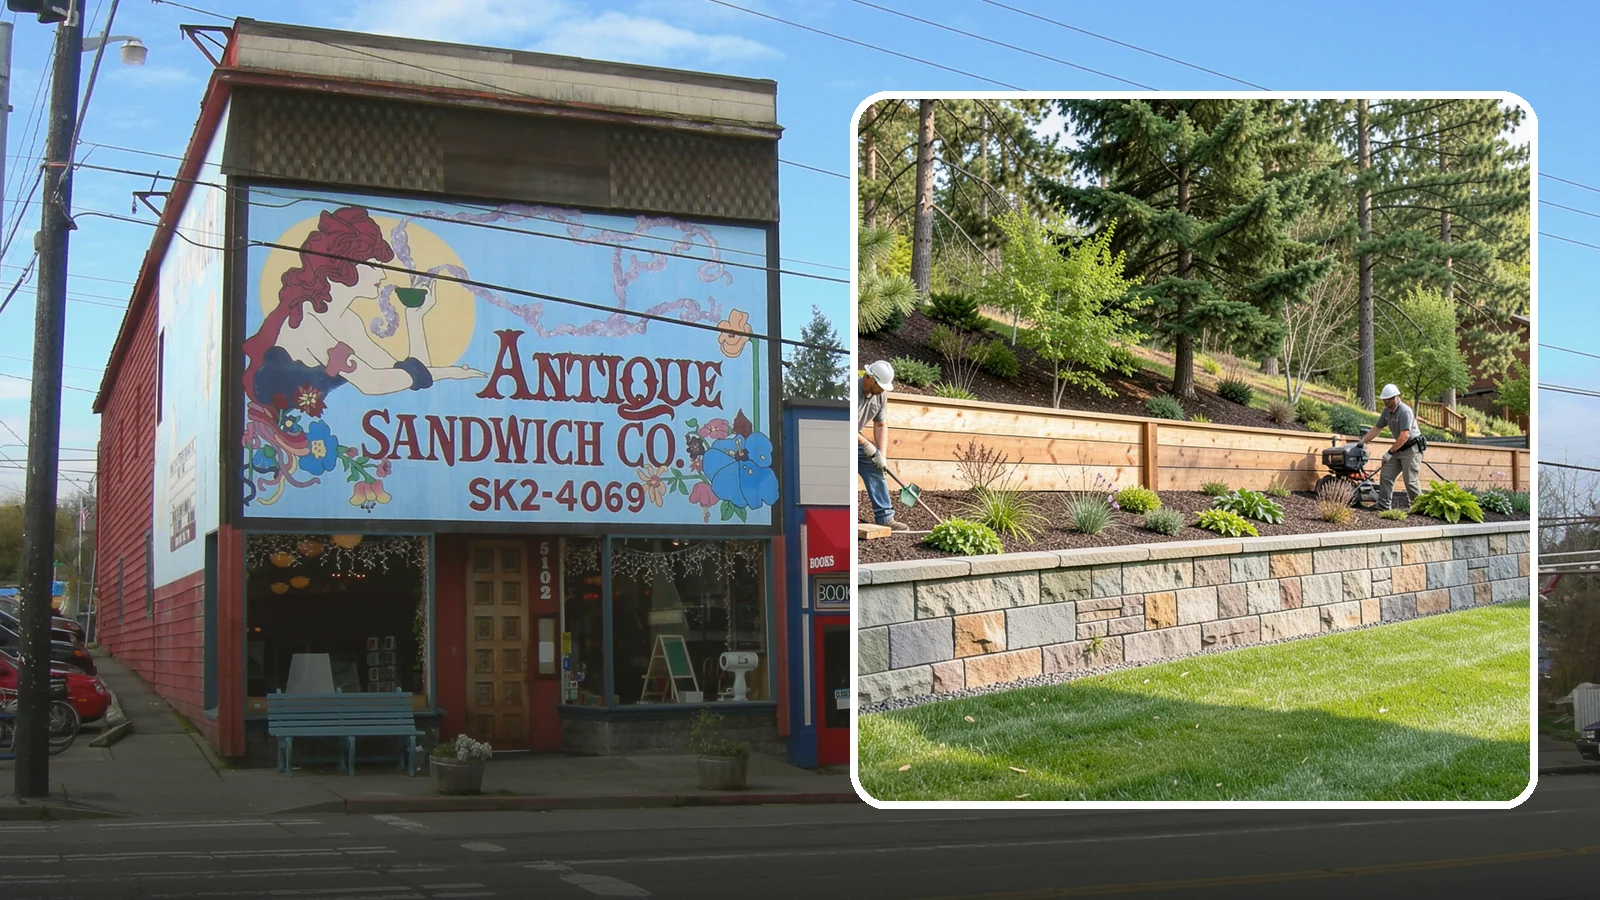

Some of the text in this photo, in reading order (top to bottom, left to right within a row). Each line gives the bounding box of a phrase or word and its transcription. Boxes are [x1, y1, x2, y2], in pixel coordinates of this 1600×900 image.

[475, 329, 723, 420] ANTIQUE
[361, 408, 685, 469] SANDWICH CO.
[468, 477, 646, 513] SK2-4069
[540, 542, 551, 599] 5102
[810, 555, 835, 568] BOOKS
